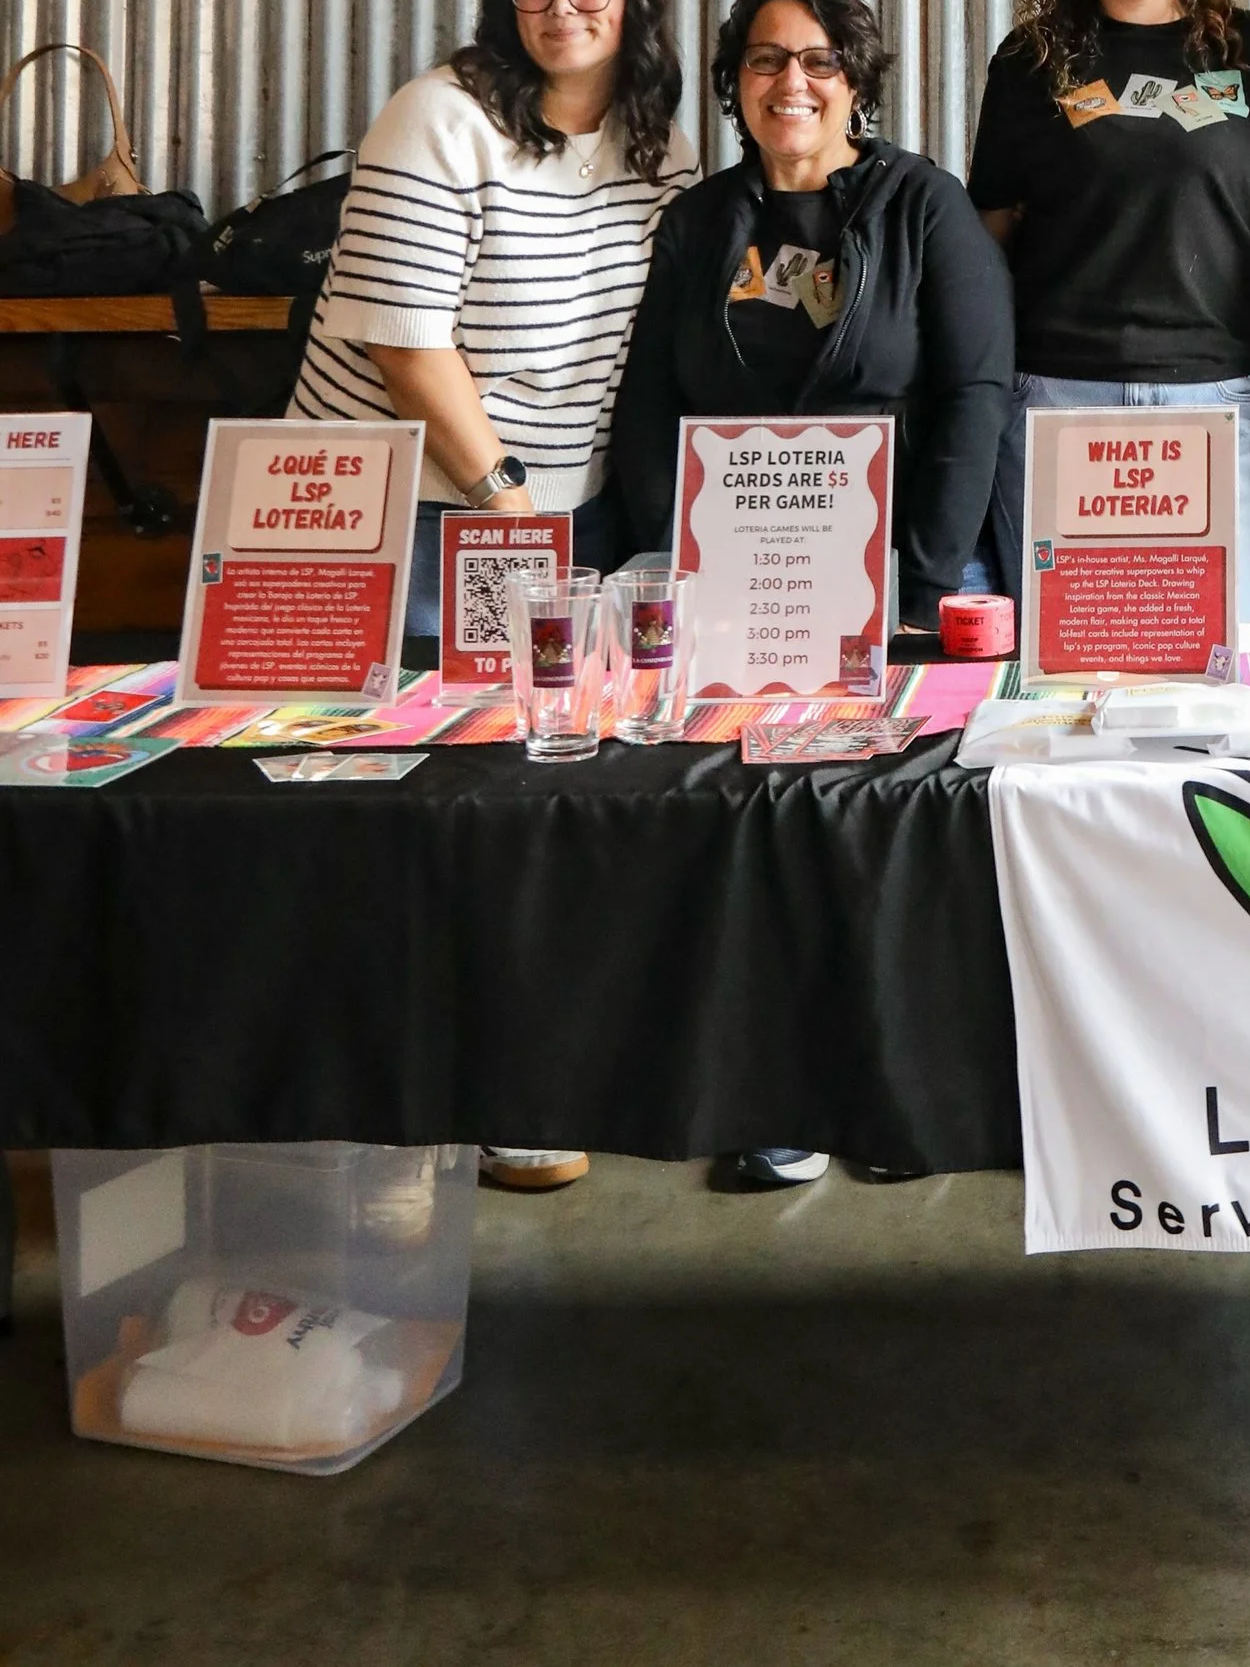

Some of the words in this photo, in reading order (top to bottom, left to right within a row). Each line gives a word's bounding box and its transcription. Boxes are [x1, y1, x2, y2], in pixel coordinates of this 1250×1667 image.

[302, 248, 332, 264] Supr
[6, 431, 62, 449] HERE
[728, 451, 762, 466] LSP
[768, 450, 845, 466] LOTERIA
[1088, 441, 1154, 462] WHAT
[1161, 440, 1182, 461] IS
[268, 450, 326, 476] ¿QUÉ
[334, 456, 363, 476] ES
[722, 472, 783, 488] CARDS
[788, 472, 822, 487] ARE
[828, 471, 849, 488] $5
[1113, 468, 1154, 490] LSP
[290, 482, 332, 502] LSP
[735, 494, 770, 510] PER
[776, 494, 834, 510] GAME!
[1078, 495, 1190, 517] LOTERIA?
[253, 504, 362, 530] LOTERÍA?
[459, 528, 504, 545] SCAN
[509, 528, 553, 544] HERE
[771, 525, 800, 533] GAMES
[753, 553, 781, 566] 1:30
[785, 556, 811, 568] pm
[1056, 554, 1074, 564] LSP's
[1078, 554, 1108, 563] in-house
[1133, 554, 1146, 563] Ms.
[1150, 554, 1178, 564] Magalli
[1060, 568, 1078, 576] used
[1080, 567, 1092, 576] her
[1095, 567, 1124, 576] creative
[1127, 567, 1174, 577] superpowers
[1187, 566, 1205, 576] whip
[750, 578, 783, 590] 2:00
[788, 580, 812, 593] pm
[1070, 580, 1080, 590] up
[1083, 580, 1094, 588] the
[1096, 580, 1109, 588] LSP
[1111, 579, 1136, 588] Loteria
[1138, 579, 1160, 588] Deck.
[1162, 578, 1195, 590] Drawing
[1065, 592, 1104, 602] inspiration
[1107, 592, 1124, 600] from
[1126, 592, 1138, 600] the
[1140, 591, 1164, 600] classic
[1167, 591, 1200, 600] Mexican
[750, 603, 780, 616] 2:30
[785, 606, 810, 618] pm
[1070, 604, 1094, 613] Loteria
[1097, 606, 1120, 615] game,
[1124, 604, 1136, 612] she
[1139, 604, 1164, 612] added
[1174, 604, 1194, 614] fresh,
[955, 617, 985, 626] TICKET
[1059, 617, 1088, 626] modern
[1090, 617, 1108, 626] flair,
[1110, 616, 1138, 626] making
[1140, 616, 1158, 624] each
[1162, 616, 1179, 624] card
[1189, 616, 1205, 624] total
[747, 628, 780, 640] 3:00
[785, 630, 810, 642] pm
[1088, 629, 1109, 637] cards
[1112, 629, 1138, 637] include
[1141, 629, 1194, 638] representation
[1196, 628, 1205, 636] of
[1064, 642, 1080, 652] lsp's
[1083, 644, 1092, 652] yp
[1095, 643, 1130, 652] program,
[1133, 642, 1155, 650] iconic
[1158, 643, 1173, 652] pop
[1175, 641, 1200, 649] culture
[474, 658, 498, 673] TO
[747, 653, 778, 665] 3:30
[782, 655, 808, 668] pm
[1080, 655, 1106, 664] events,
[1108, 654, 1124, 662] and
[1126, 654, 1149, 664] things
[1165, 654, 1182, 662] love.
